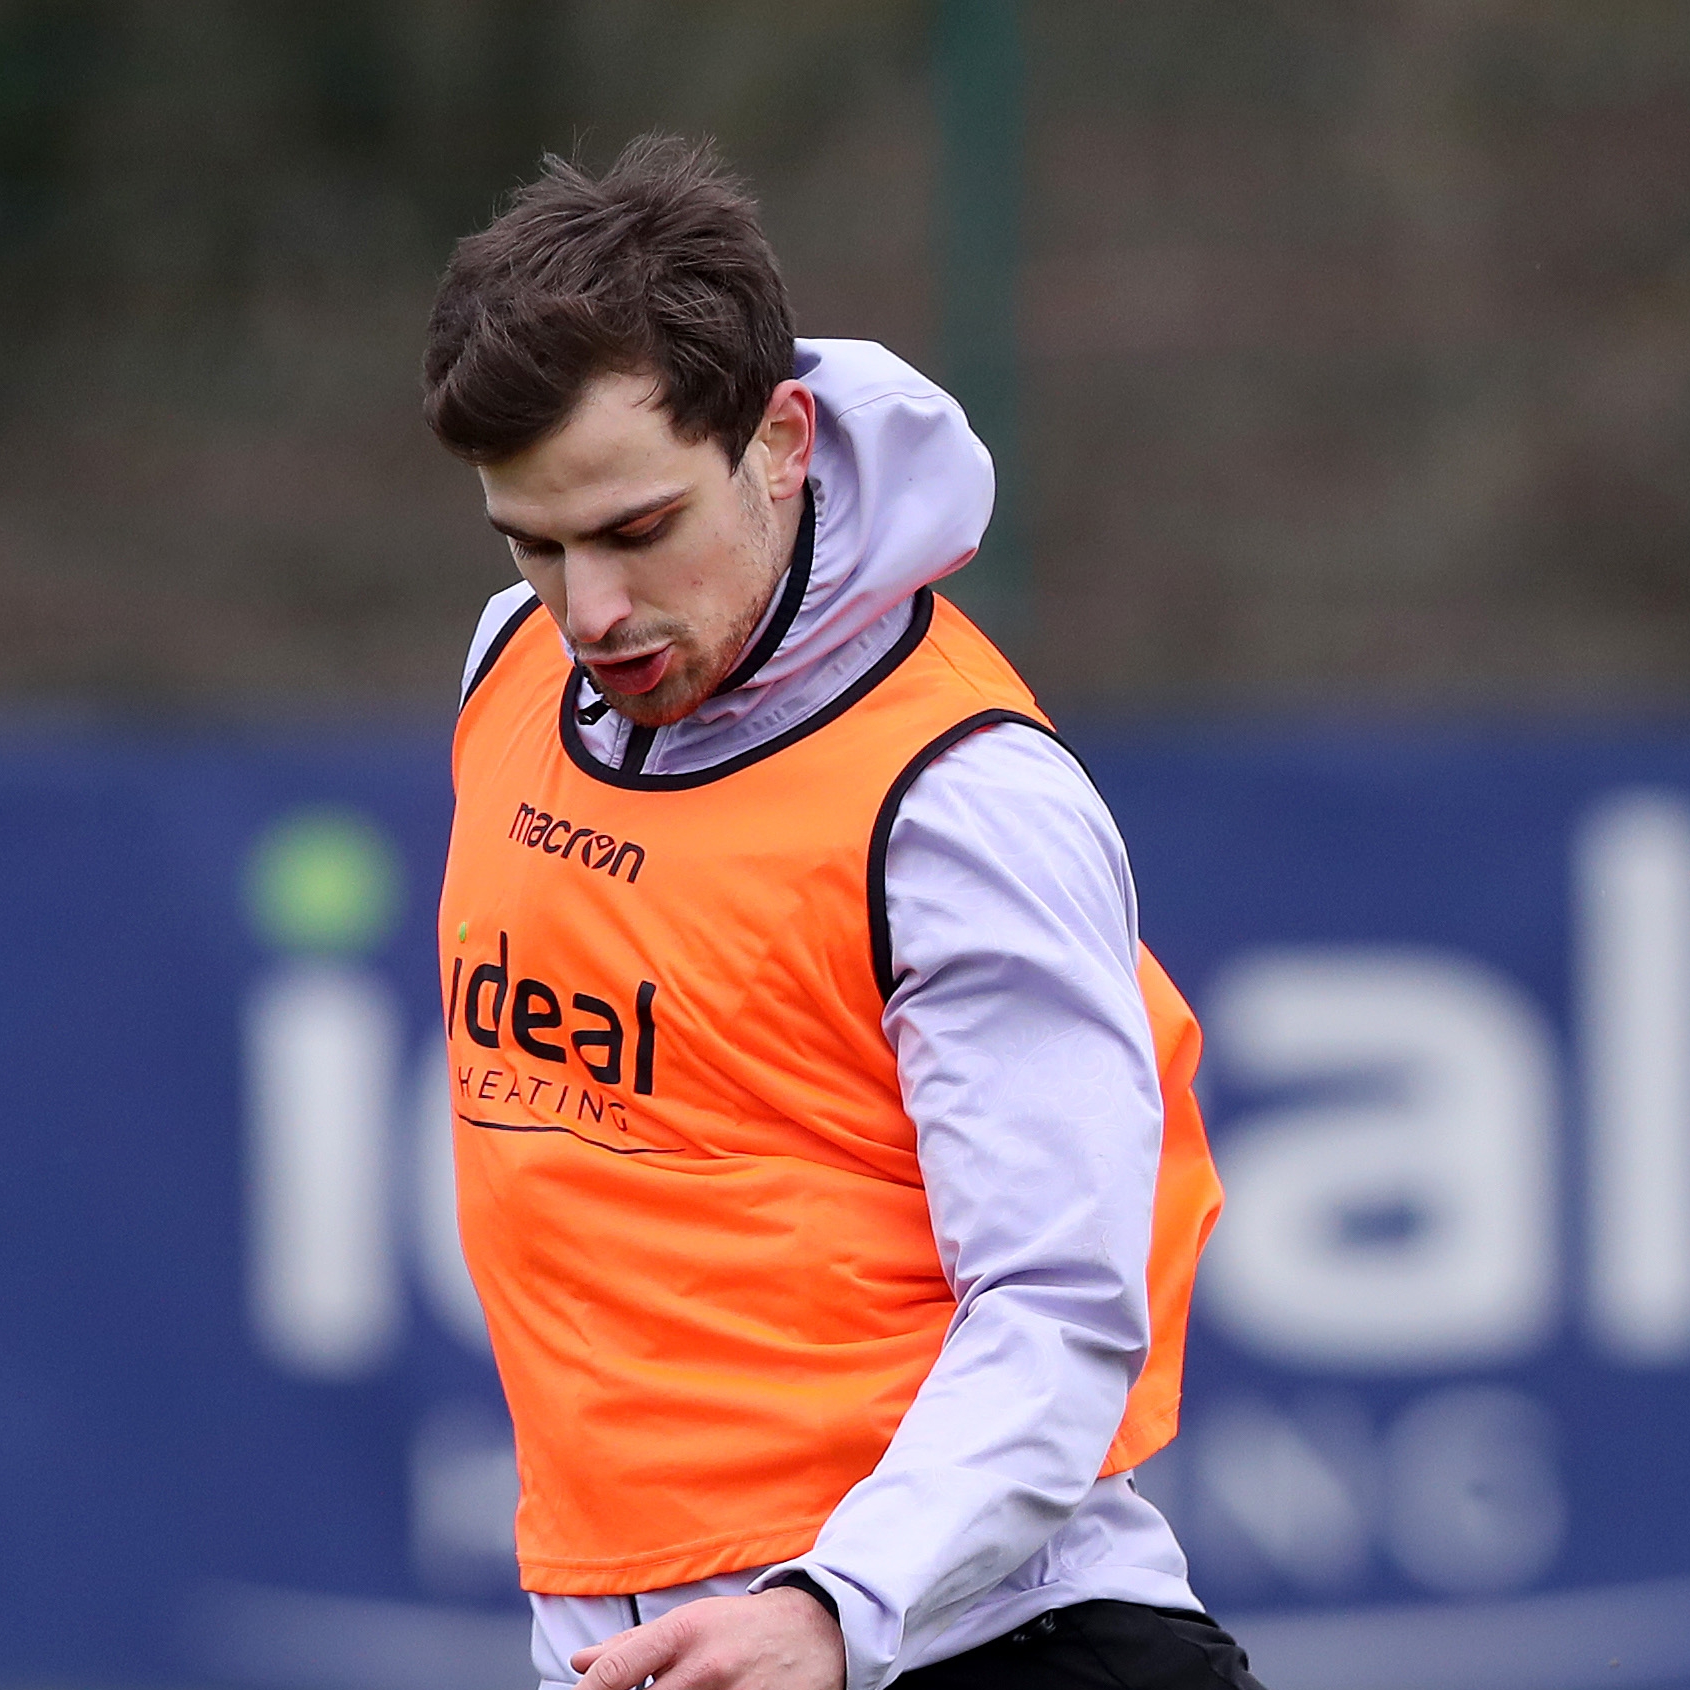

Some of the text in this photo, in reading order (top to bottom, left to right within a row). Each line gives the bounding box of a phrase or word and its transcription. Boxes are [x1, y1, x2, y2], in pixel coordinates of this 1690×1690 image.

[508, 802, 646, 884] macron
[448, 921, 657, 1097] ideal
[457, 1065, 629, 1133] HEATING
